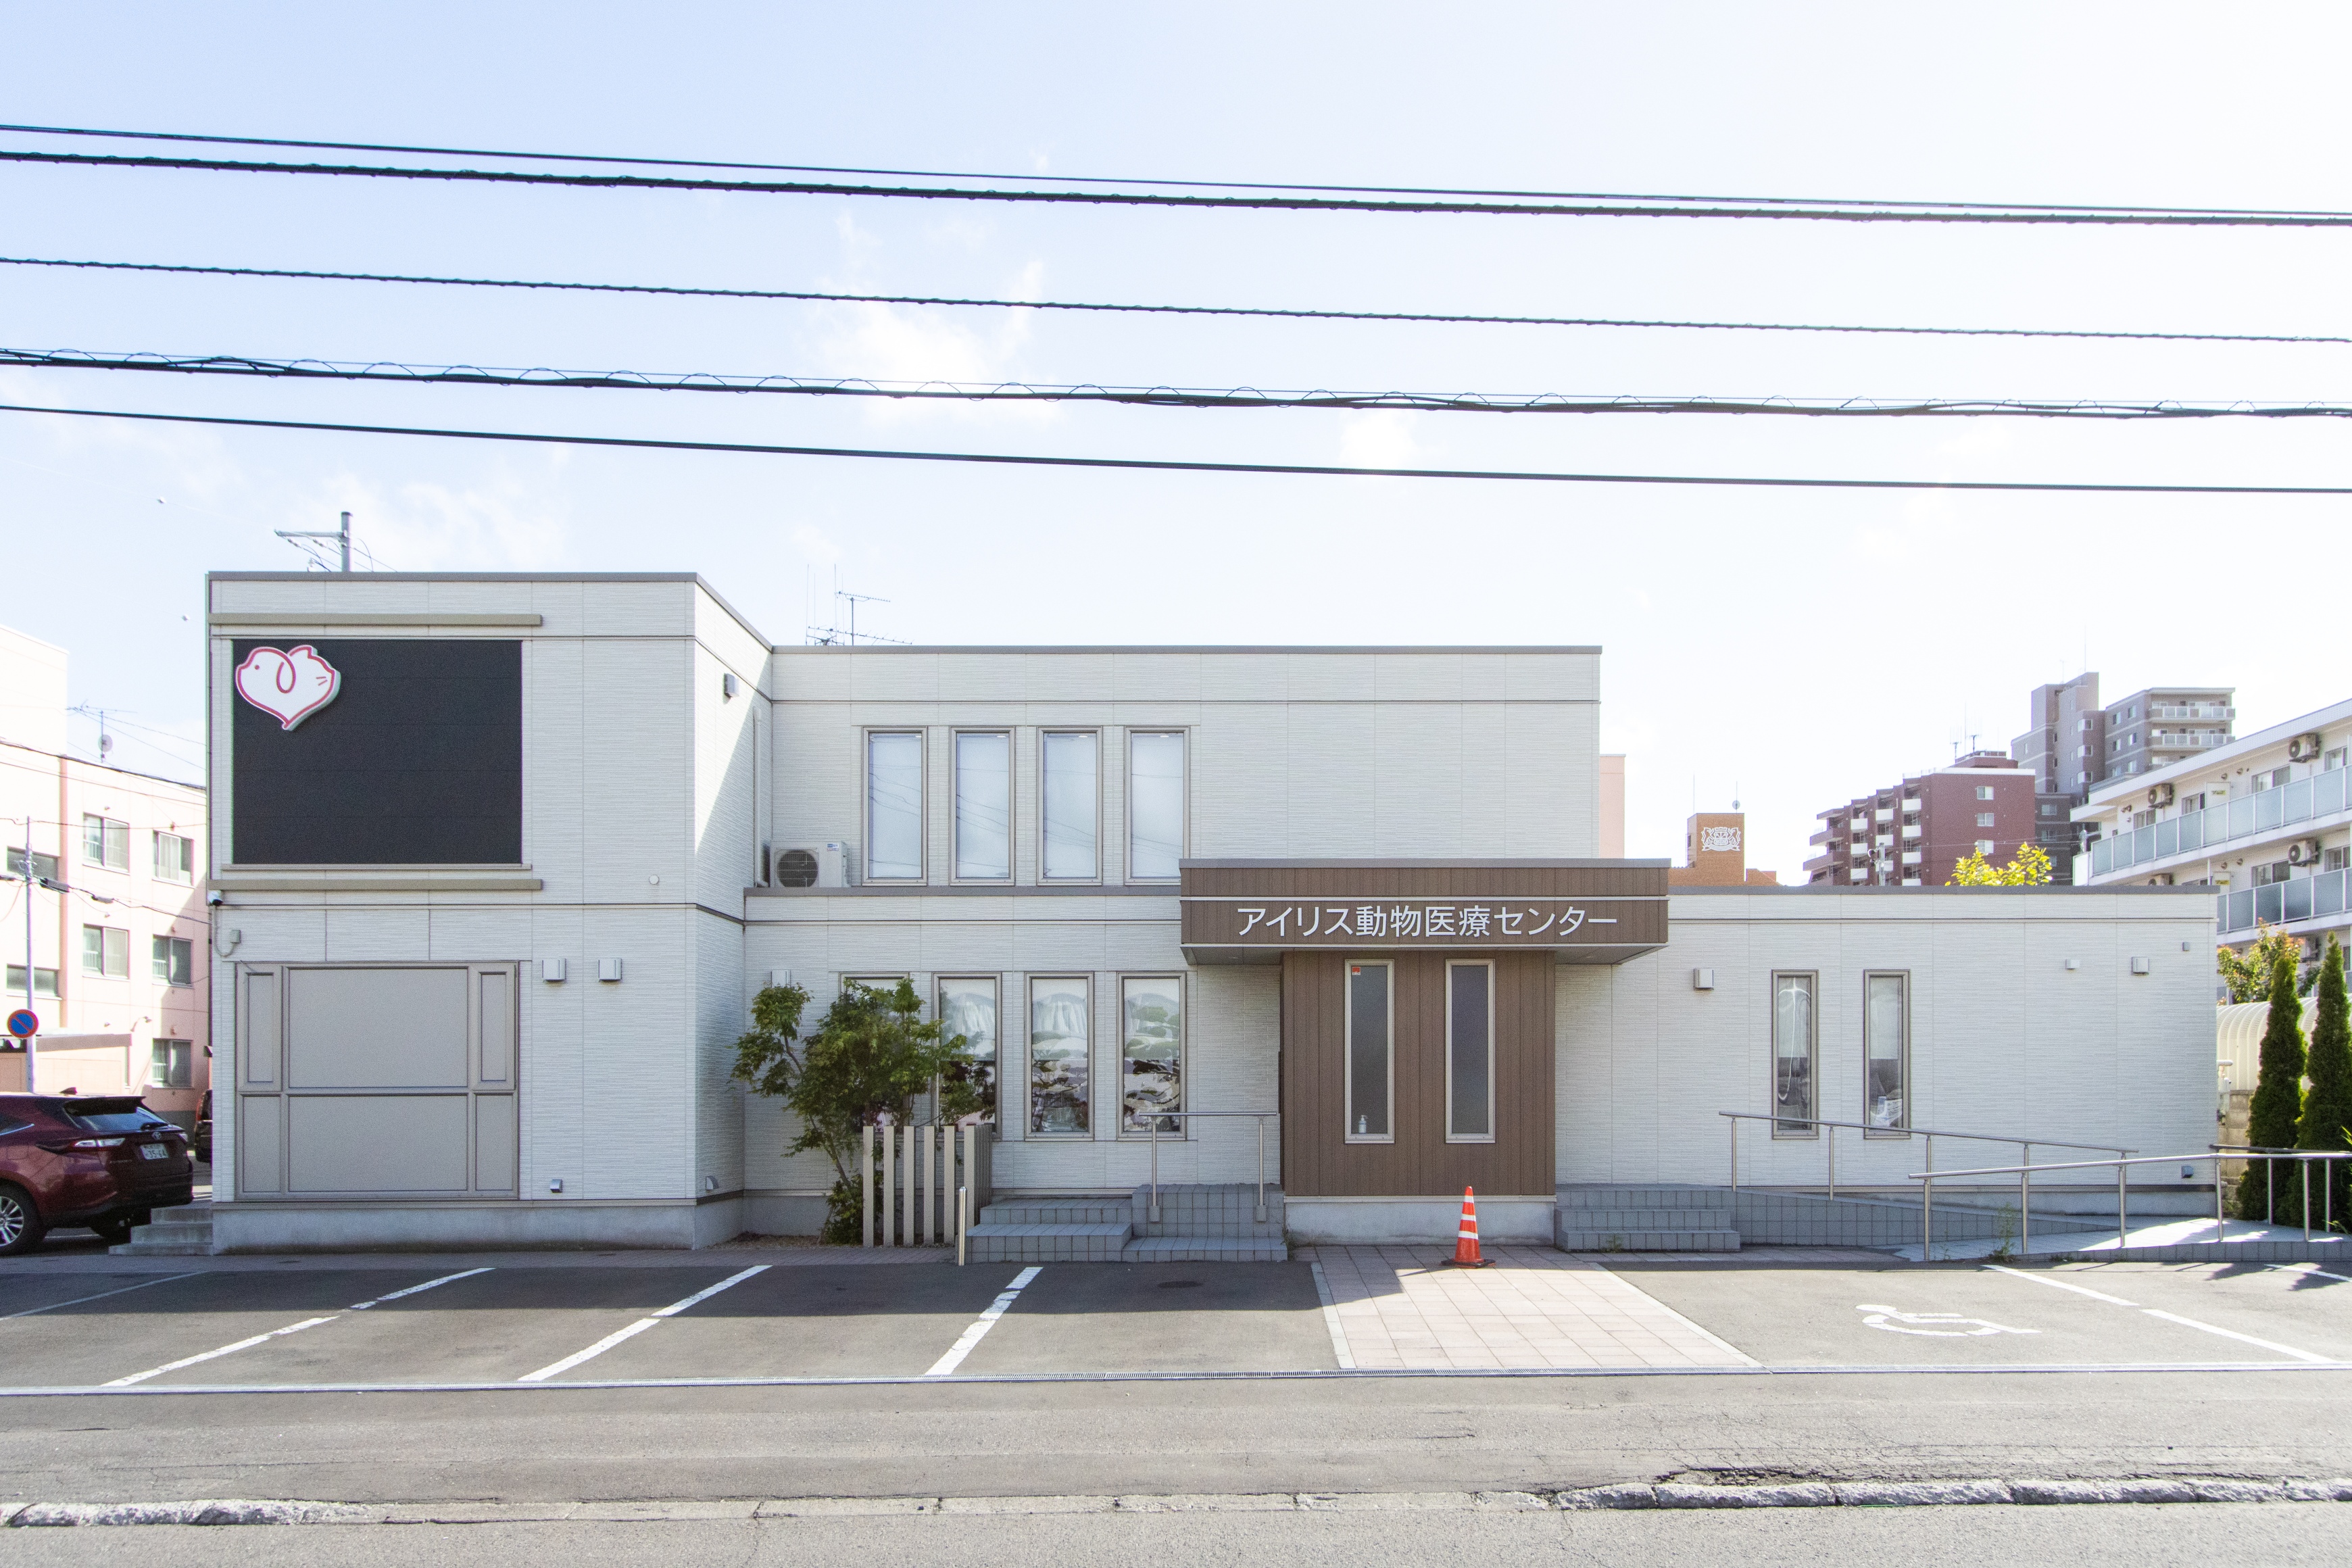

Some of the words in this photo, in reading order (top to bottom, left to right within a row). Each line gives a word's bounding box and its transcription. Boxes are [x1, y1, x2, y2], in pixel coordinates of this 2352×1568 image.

[1238, 905, 1617, 937] アイリス動物医療センター
